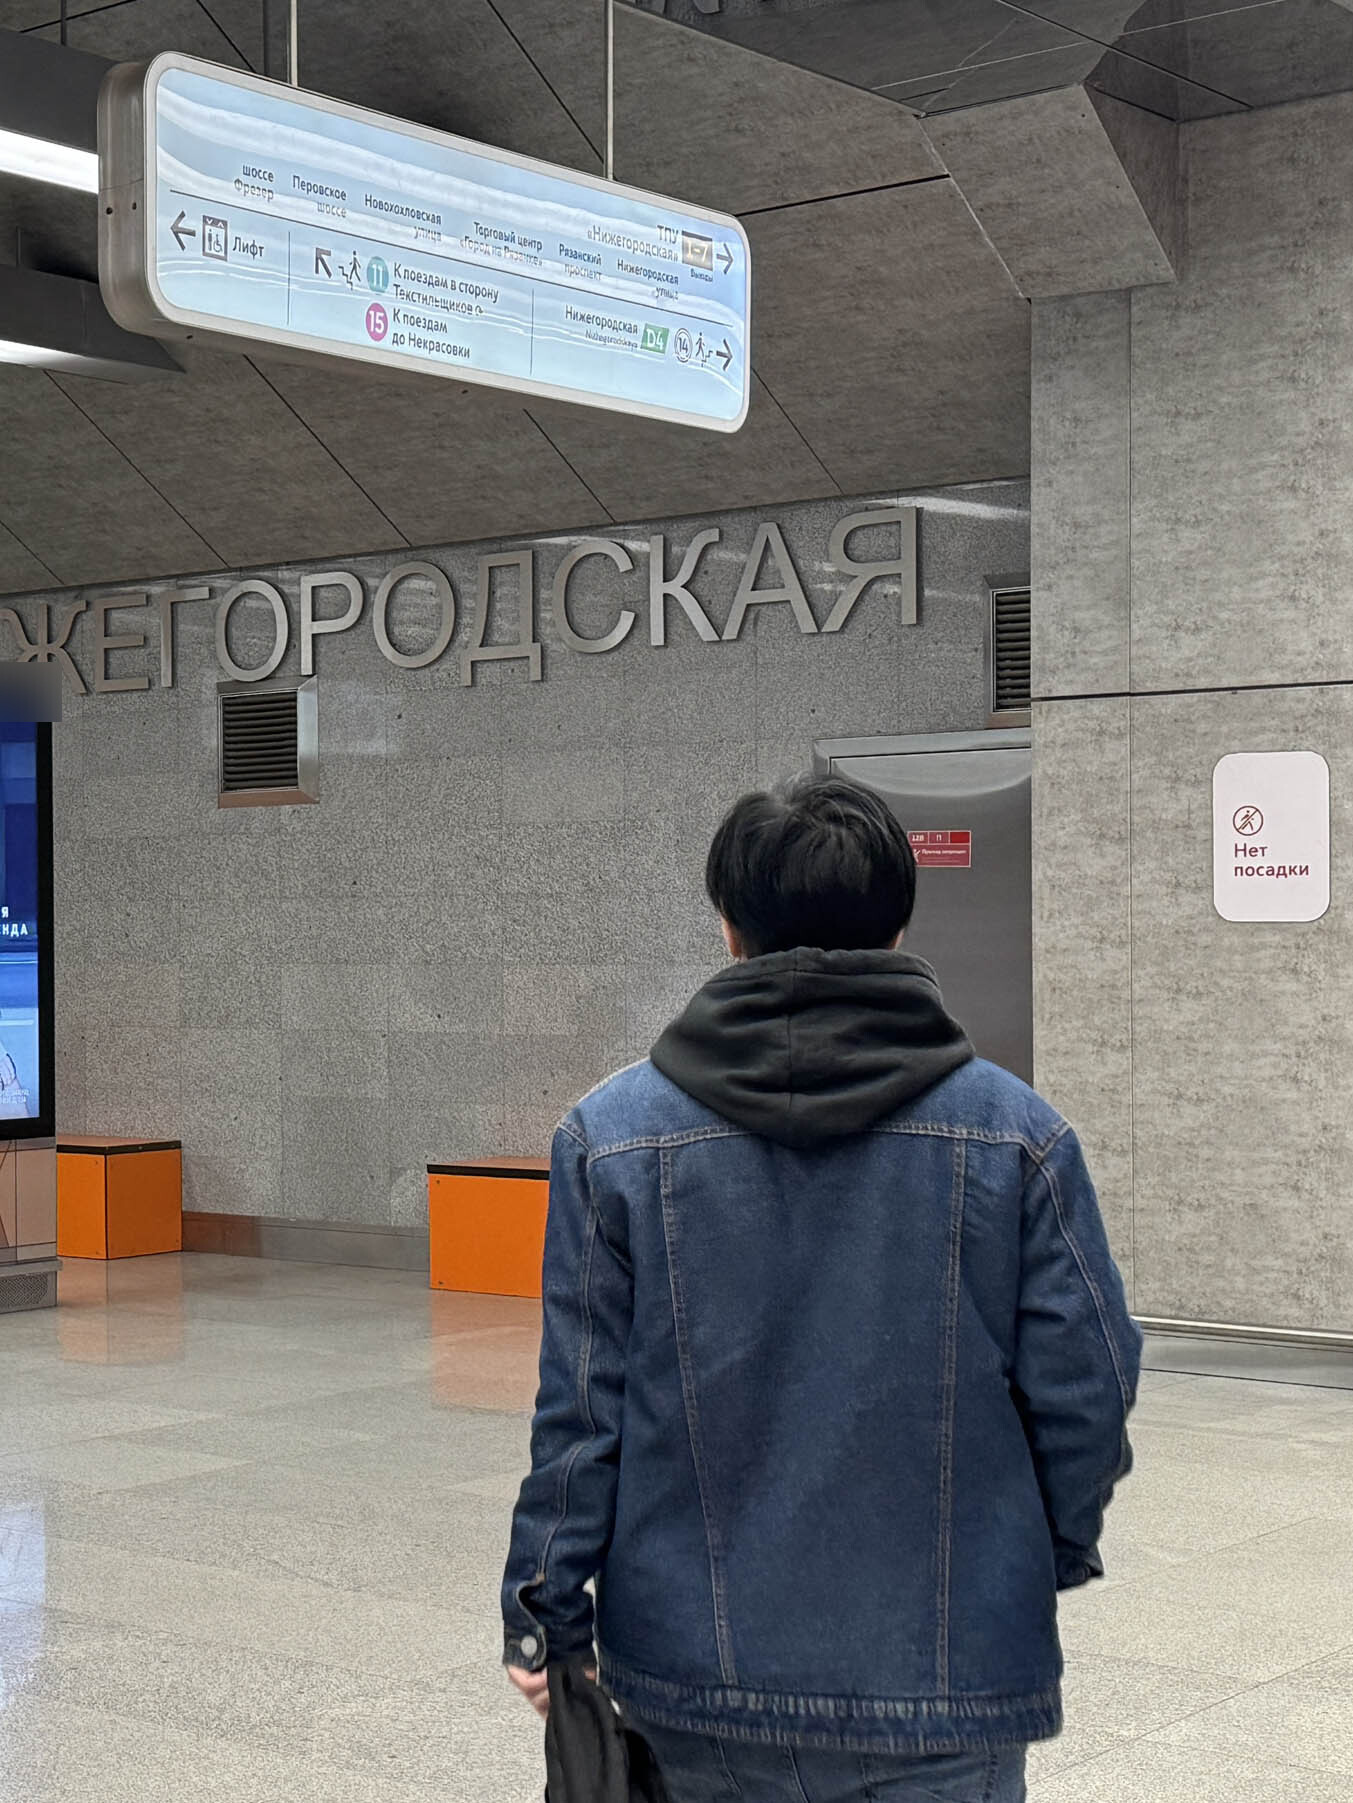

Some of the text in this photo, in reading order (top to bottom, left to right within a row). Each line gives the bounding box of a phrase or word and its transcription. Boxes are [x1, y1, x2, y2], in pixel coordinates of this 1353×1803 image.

[242, 165, 274, 183] шоссе
[233, 178, 274, 203] Фрезер
[292, 175, 347, 201] Перовское
[317, 202, 347, 218] шоссе
[364, 193, 442, 225] Новохохловская
[473, 221, 543, 252] Торговый центр
[587, 225, 679, 262] «Нижегородская»
[656, 225, 679, 244] ТПУ
[232, 236, 265, 260] Лифт
[559, 243, 602, 265] Рязанский
[371, 263, 385, 288] 11
[393, 262, 499, 304] К поездам в сторону
[617, 258, 679, 285] Нижегородская
[393, 283, 473, 316] Текстильщиков
[368, 310, 385, 334] 15
[392, 308, 448, 334] К поездам
[565, 304, 638, 335] Нижегородская
[392, 332, 470, 359] до Некрасовки
[678, 337, 689, 354] 14
[1234, 843, 1269, 858] Нет
[1234, 864, 1310, 879] посадки
